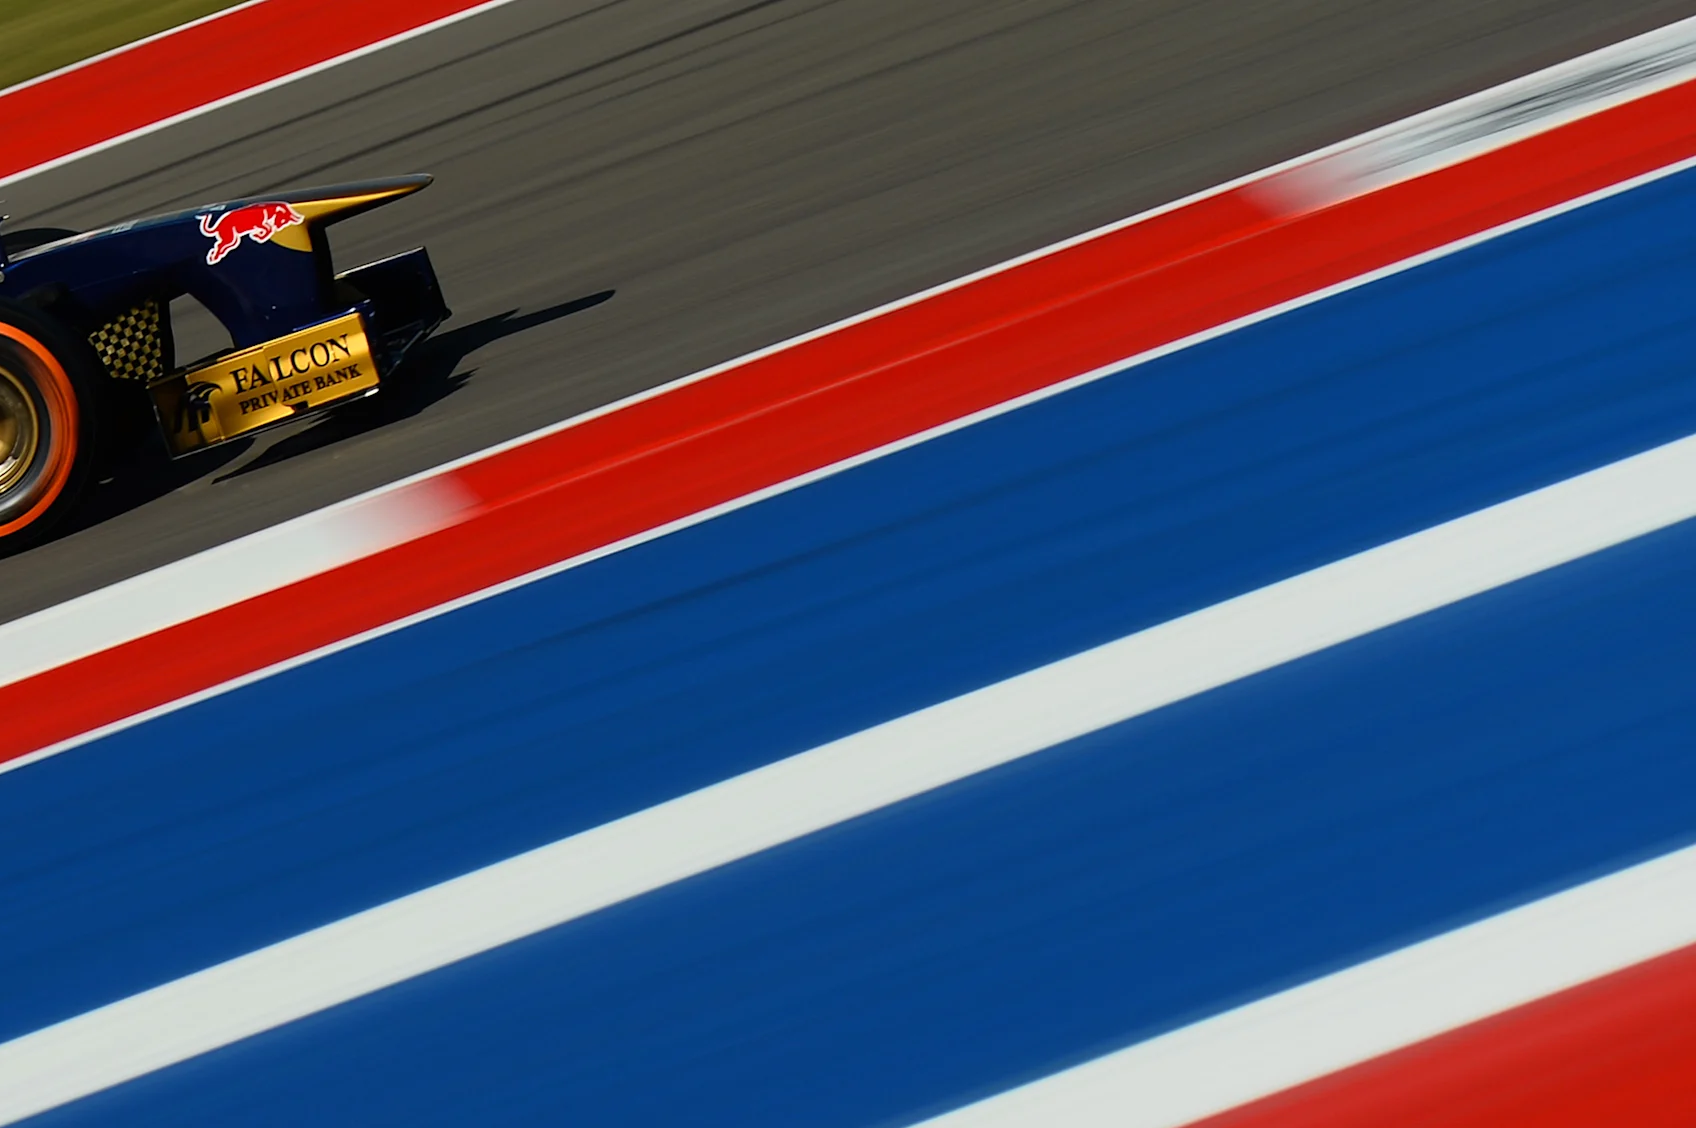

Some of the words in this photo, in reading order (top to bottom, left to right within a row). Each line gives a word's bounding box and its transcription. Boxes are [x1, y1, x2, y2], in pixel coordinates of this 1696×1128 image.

[230, 333, 353, 395] FALCON
[239, 379, 312, 415] PRIVATE
[313, 363, 363, 392] BANK
